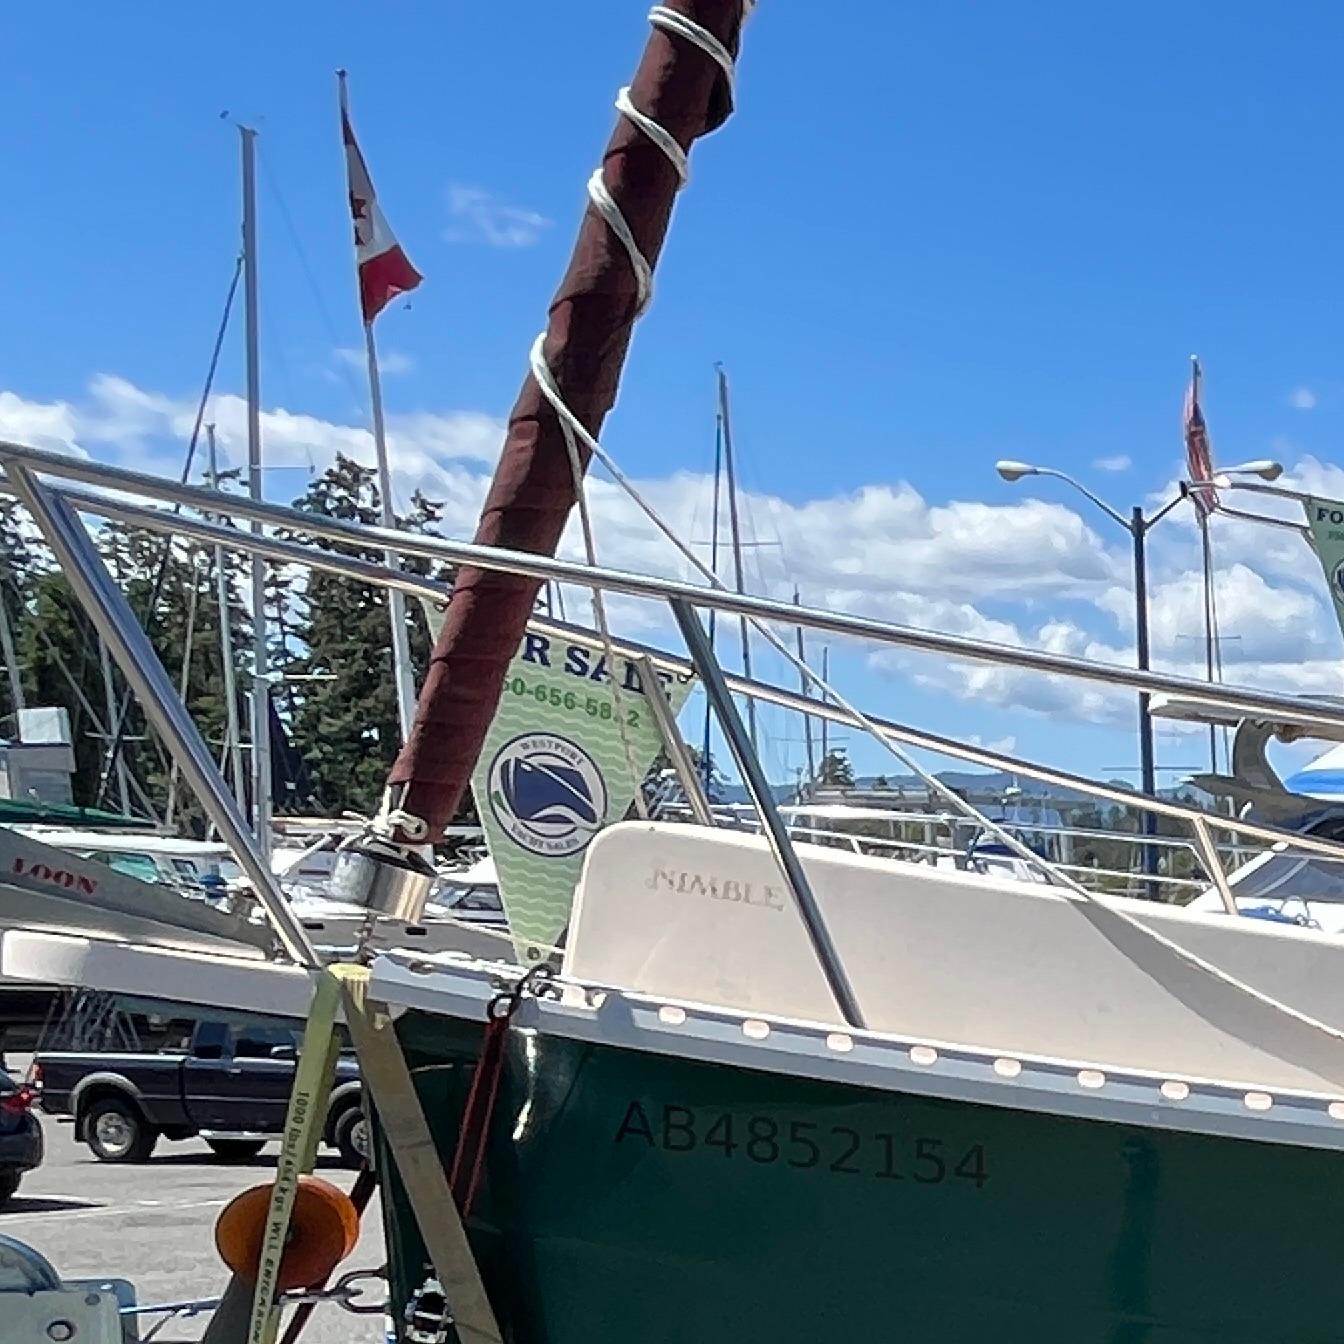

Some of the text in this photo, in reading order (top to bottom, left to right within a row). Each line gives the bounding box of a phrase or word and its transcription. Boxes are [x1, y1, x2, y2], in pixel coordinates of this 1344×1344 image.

[645, 865, 784, 912] NIMBLE
[293, 1090, 310, 1125] 1000
[614, 1100, 989, 1189] AB4852154
